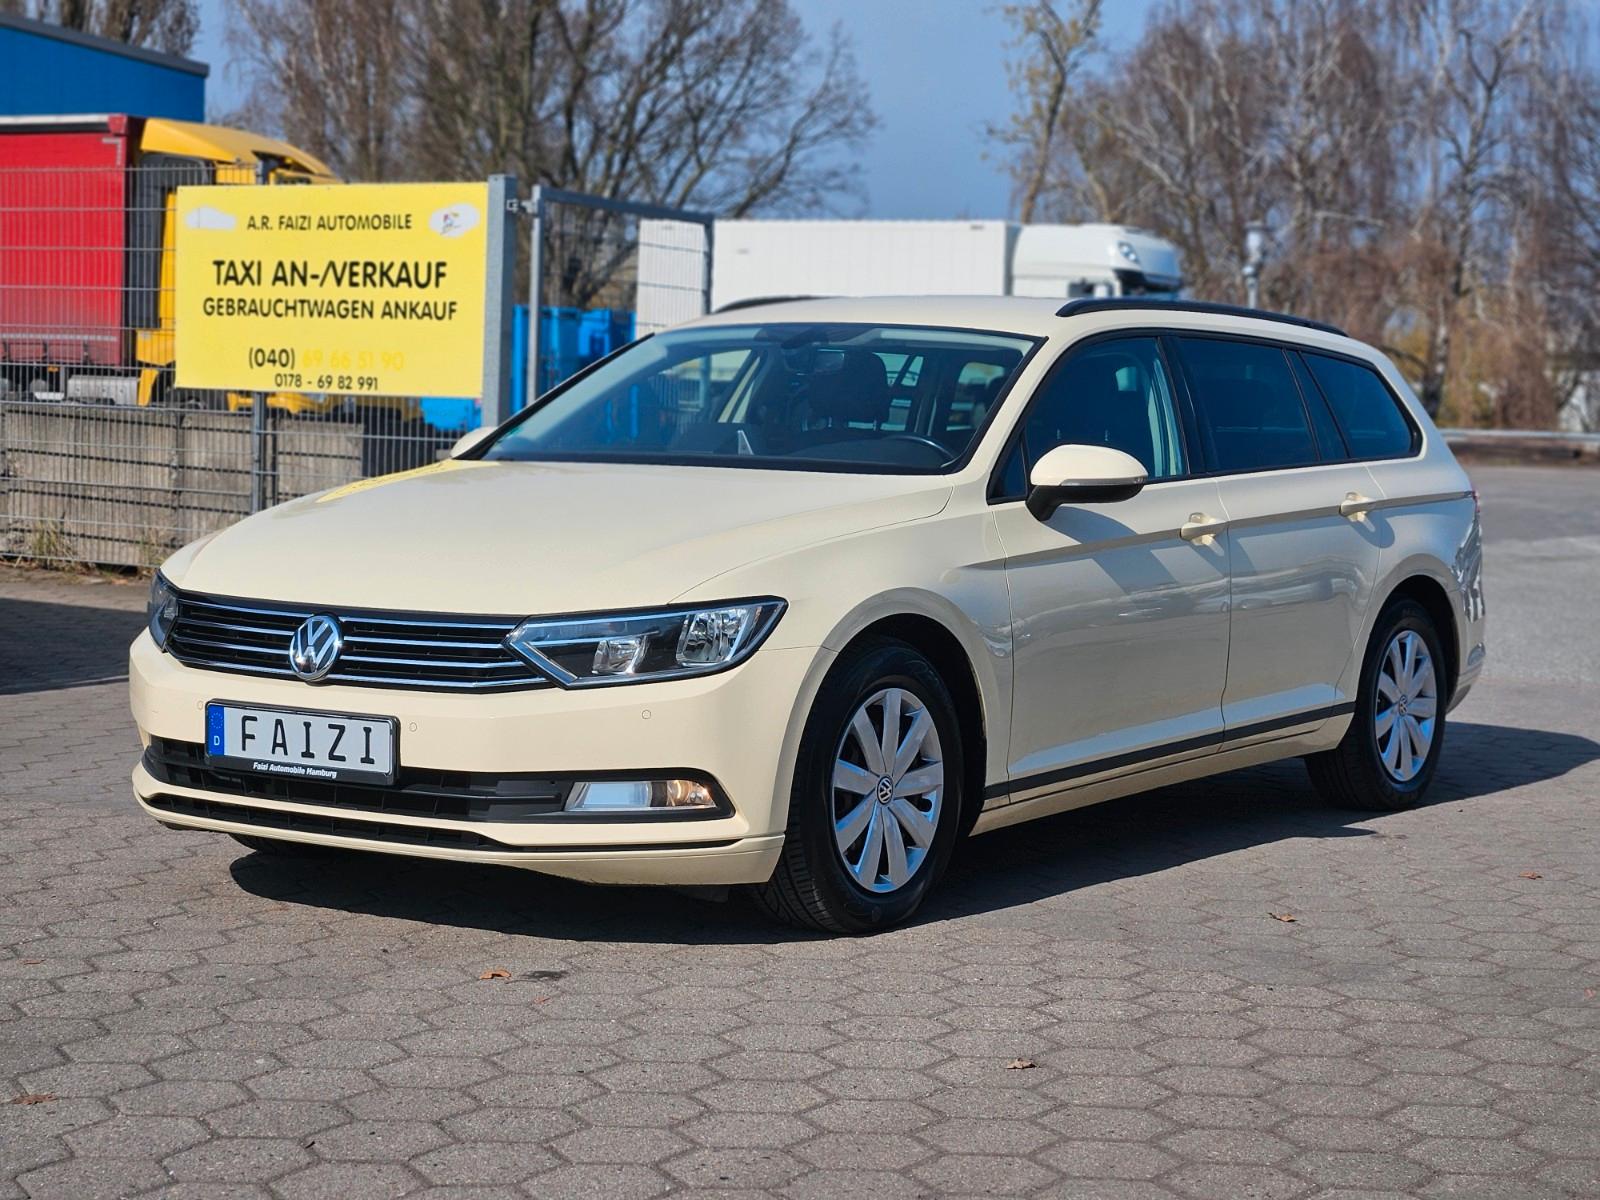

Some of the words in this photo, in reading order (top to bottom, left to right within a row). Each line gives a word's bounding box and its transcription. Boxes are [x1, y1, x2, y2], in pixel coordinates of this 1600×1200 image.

[247, 216, 273, 231] A.R.
[279, 215, 311, 231] FAIZI
[316, 214, 412, 231] AUTOMOBILE
[213, 260, 262, 286] TAXI
[272, 260, 447, 288] AN-/VERKAUF
[203, 297, 374, 319] GEBRAUCHTWAGEN
[380, 301, 457, 320] ANKAUF
[249, 347, 296, 369] (040)
[274, 373, 302, 388] 0178
[317, 375, 333, 389] 69
[337, 376, 353, 390] 82
[358, 377, 378, 391] 991
[213, 735, 221, 746] D
[241, 715, 375, 765] FAIZI
[253, 761, 268, 771] Faizi
[268, 763, 306, 775] Automobile
[306, 767, 337, 779] Hamburg
